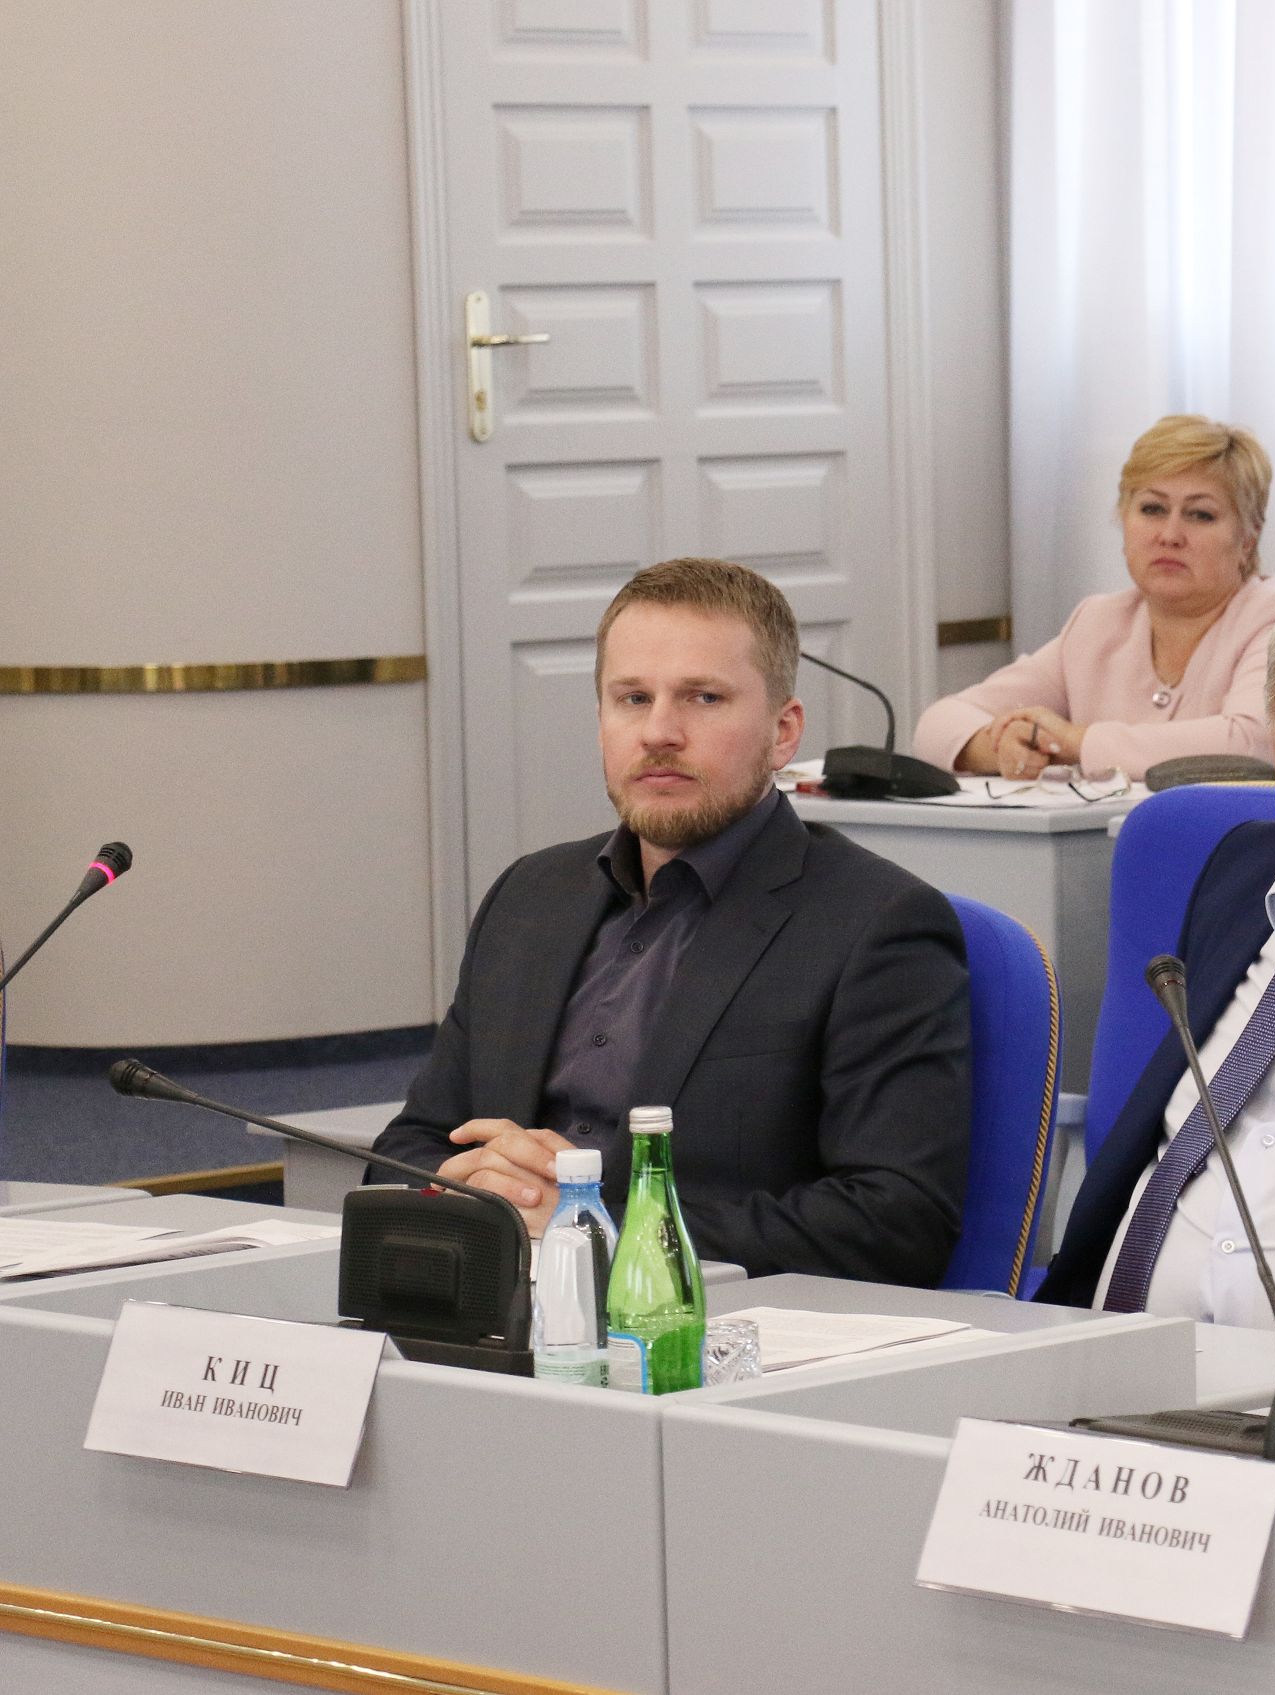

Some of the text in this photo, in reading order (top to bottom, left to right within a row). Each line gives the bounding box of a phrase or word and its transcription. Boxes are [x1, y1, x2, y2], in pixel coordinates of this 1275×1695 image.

[201, 1355, 281, 1394] КИЦ
[160, 1390, 304, 1427] ИВАН ИВАНОВИЧ
[1023, 1452, 1192, 1505] ЖДАНОВ
[978, 1498, 1213, 1554] АНАТОЛИЙ ИВАНОВИЧ
